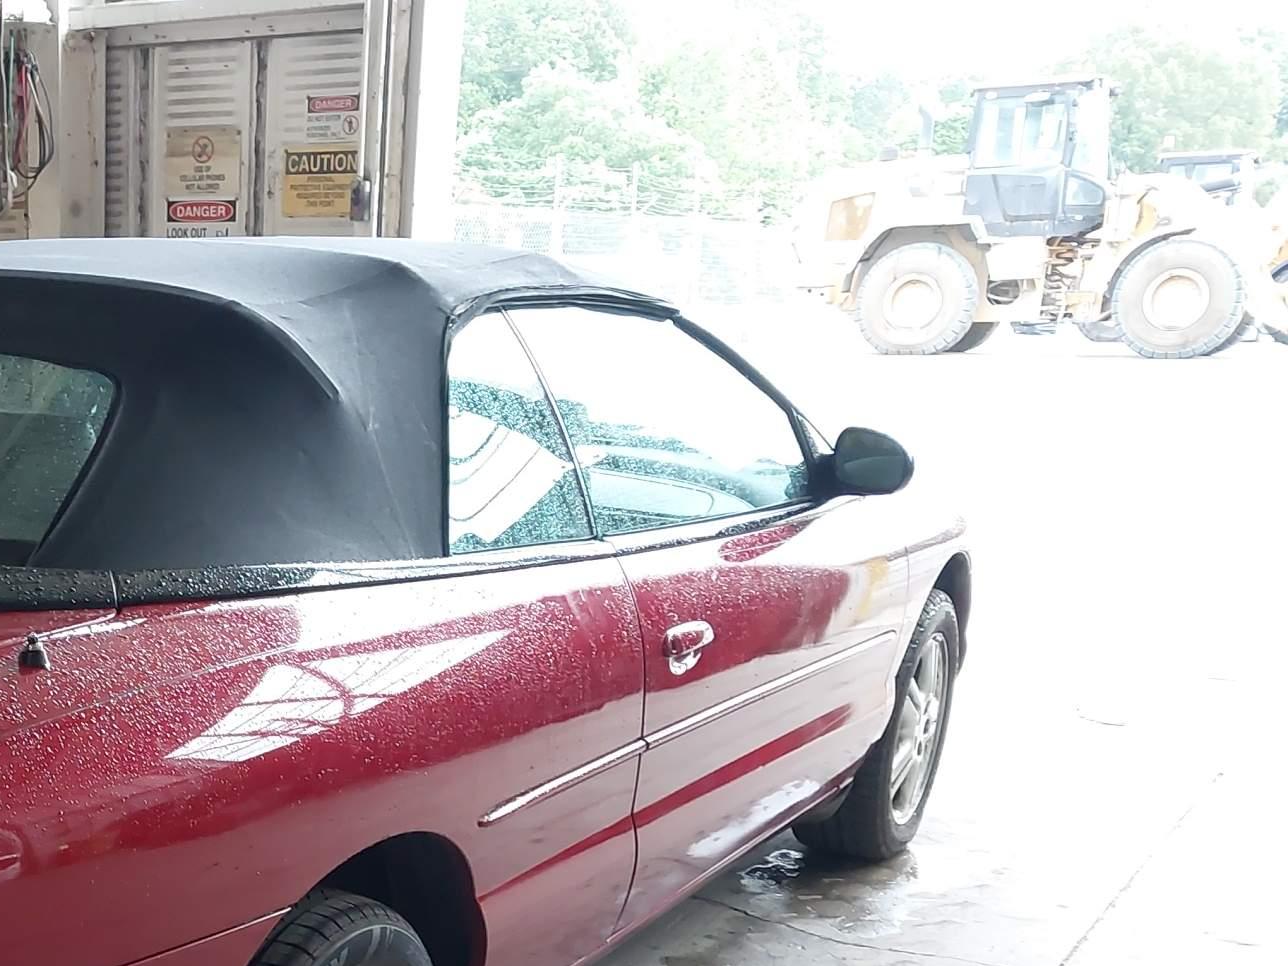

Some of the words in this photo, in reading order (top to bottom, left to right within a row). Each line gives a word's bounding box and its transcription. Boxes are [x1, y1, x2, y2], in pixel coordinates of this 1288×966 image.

[315, 98, 352, 109] DANGER
[288, 153, 357, 173] CAUTION
[176, 206, 226, 217] DANGER
[167, 228, 189, 238] LOOK
[191, 228, 207, 238] OUT
